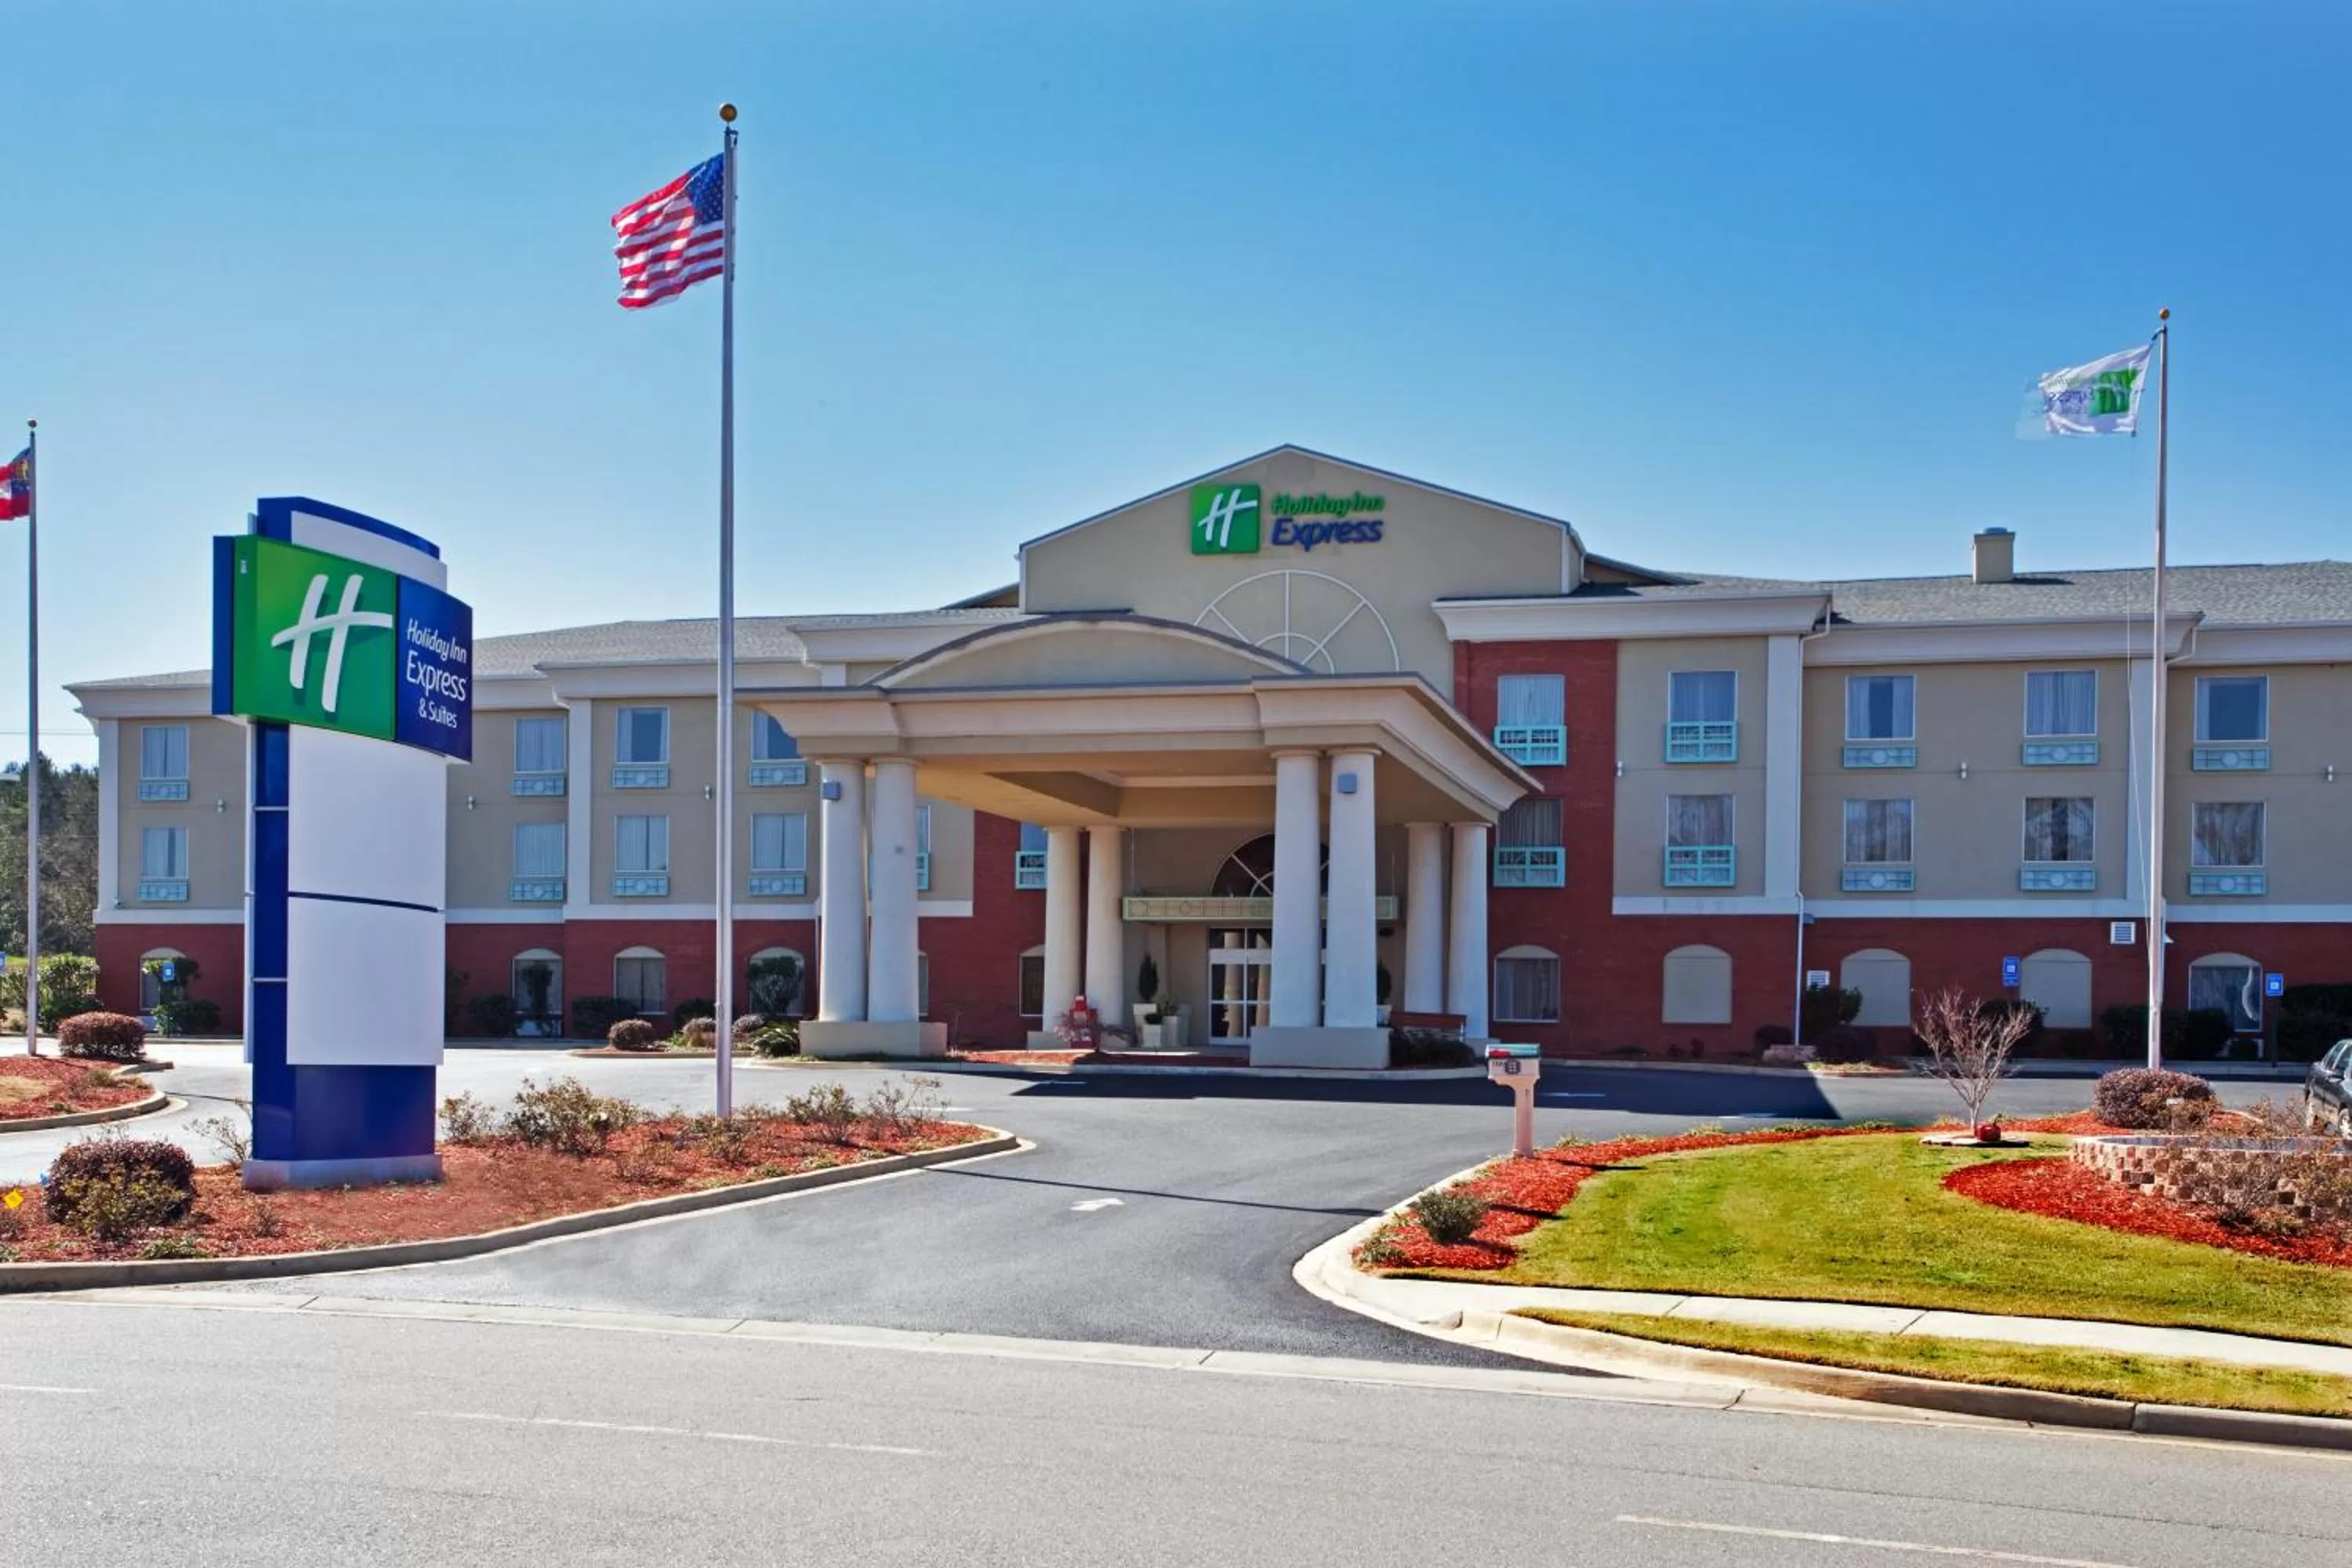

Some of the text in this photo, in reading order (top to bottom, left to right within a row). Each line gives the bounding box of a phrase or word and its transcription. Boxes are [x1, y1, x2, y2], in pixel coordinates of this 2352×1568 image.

[1272, 491, 1385, 518] Holiday Inn
[1272, 517, 1384, 553] Express
[407, 618, 466, 664] Holiday Inn
[406, 649, 466, 702] Express
[418, 697, 457, 728] & Suites
